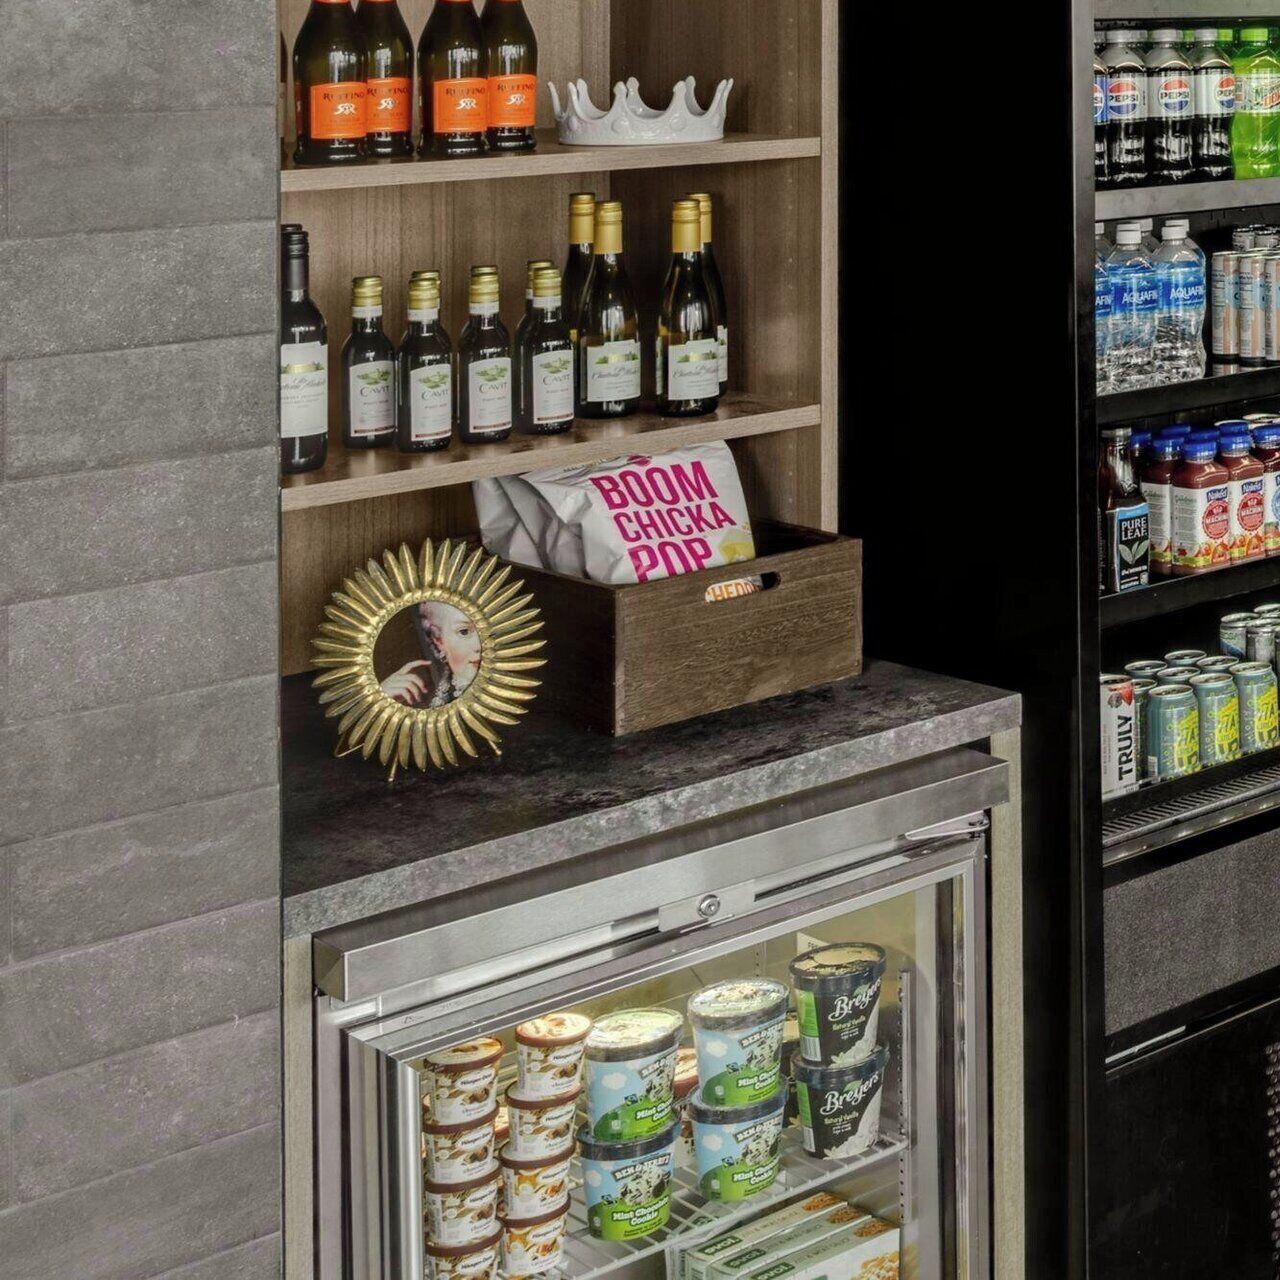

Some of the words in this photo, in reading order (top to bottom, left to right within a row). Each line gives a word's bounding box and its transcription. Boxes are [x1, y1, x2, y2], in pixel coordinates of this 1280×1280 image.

[1108, 93, 1140, 104] PEPSI
[1160, 91, 1191, 102] PEPSI
[589, 460, 719, 511] BOOM
[612, 501, 737, 543] CHICKA
[1121, 517, 1147, 532] PURE
[627, 537, 713, 584] POP
[1117, 714, 1133, 781] TRULY
[737, 1075, 759, 1087] Mint
[820, 1071, 880, 1115] Breyers
[636, 1108, 654, 1120] Mint
[732, 1171, 751, 1182] Mint
[612, 1211, 635, 1221] Mint
[630, 1210, 659, 1226] Cookie
